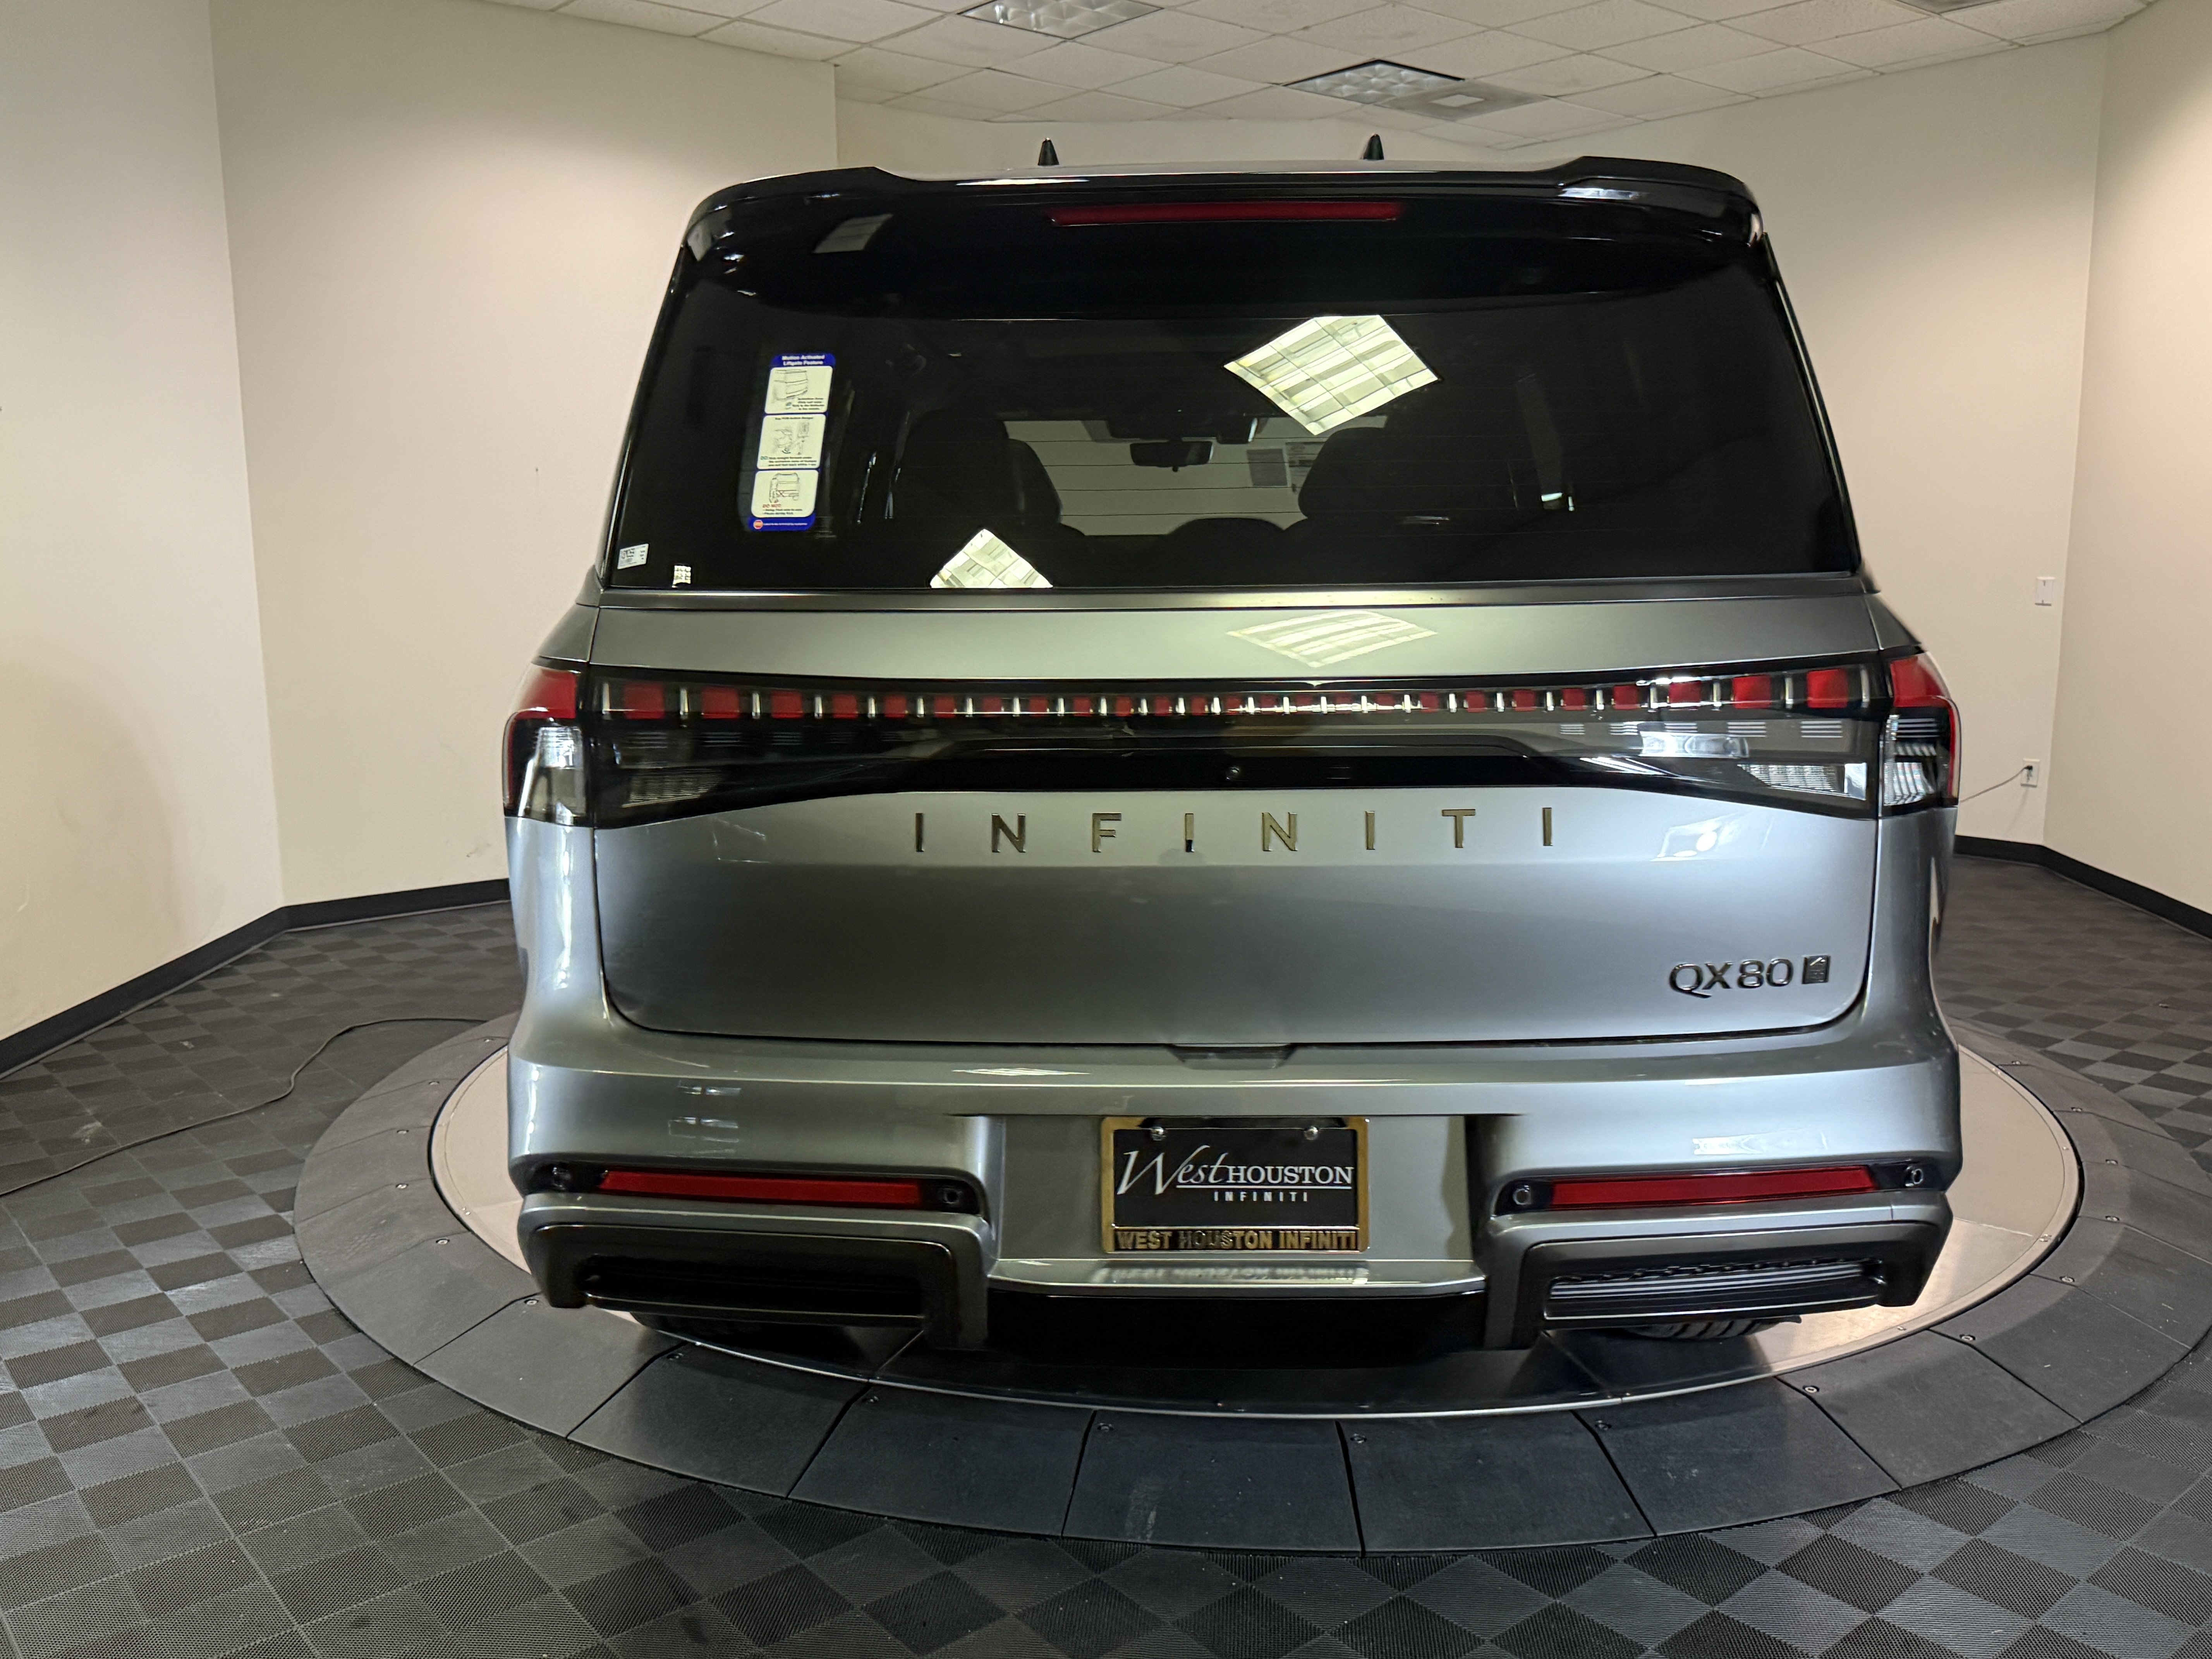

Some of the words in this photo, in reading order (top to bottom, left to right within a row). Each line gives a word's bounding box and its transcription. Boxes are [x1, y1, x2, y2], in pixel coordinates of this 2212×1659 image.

[915, 807, 1553, 853] INFINITI
[1669, 958, 1794, 998] QX80
[1214, 1191, 1308, 1202] INFINITI
[1115, 1230, 1173, 1250] WEST
[1178, 1230, 1273, 1249] HOUSTON
[1279, 1231, 1356, 1249] INFINITI
